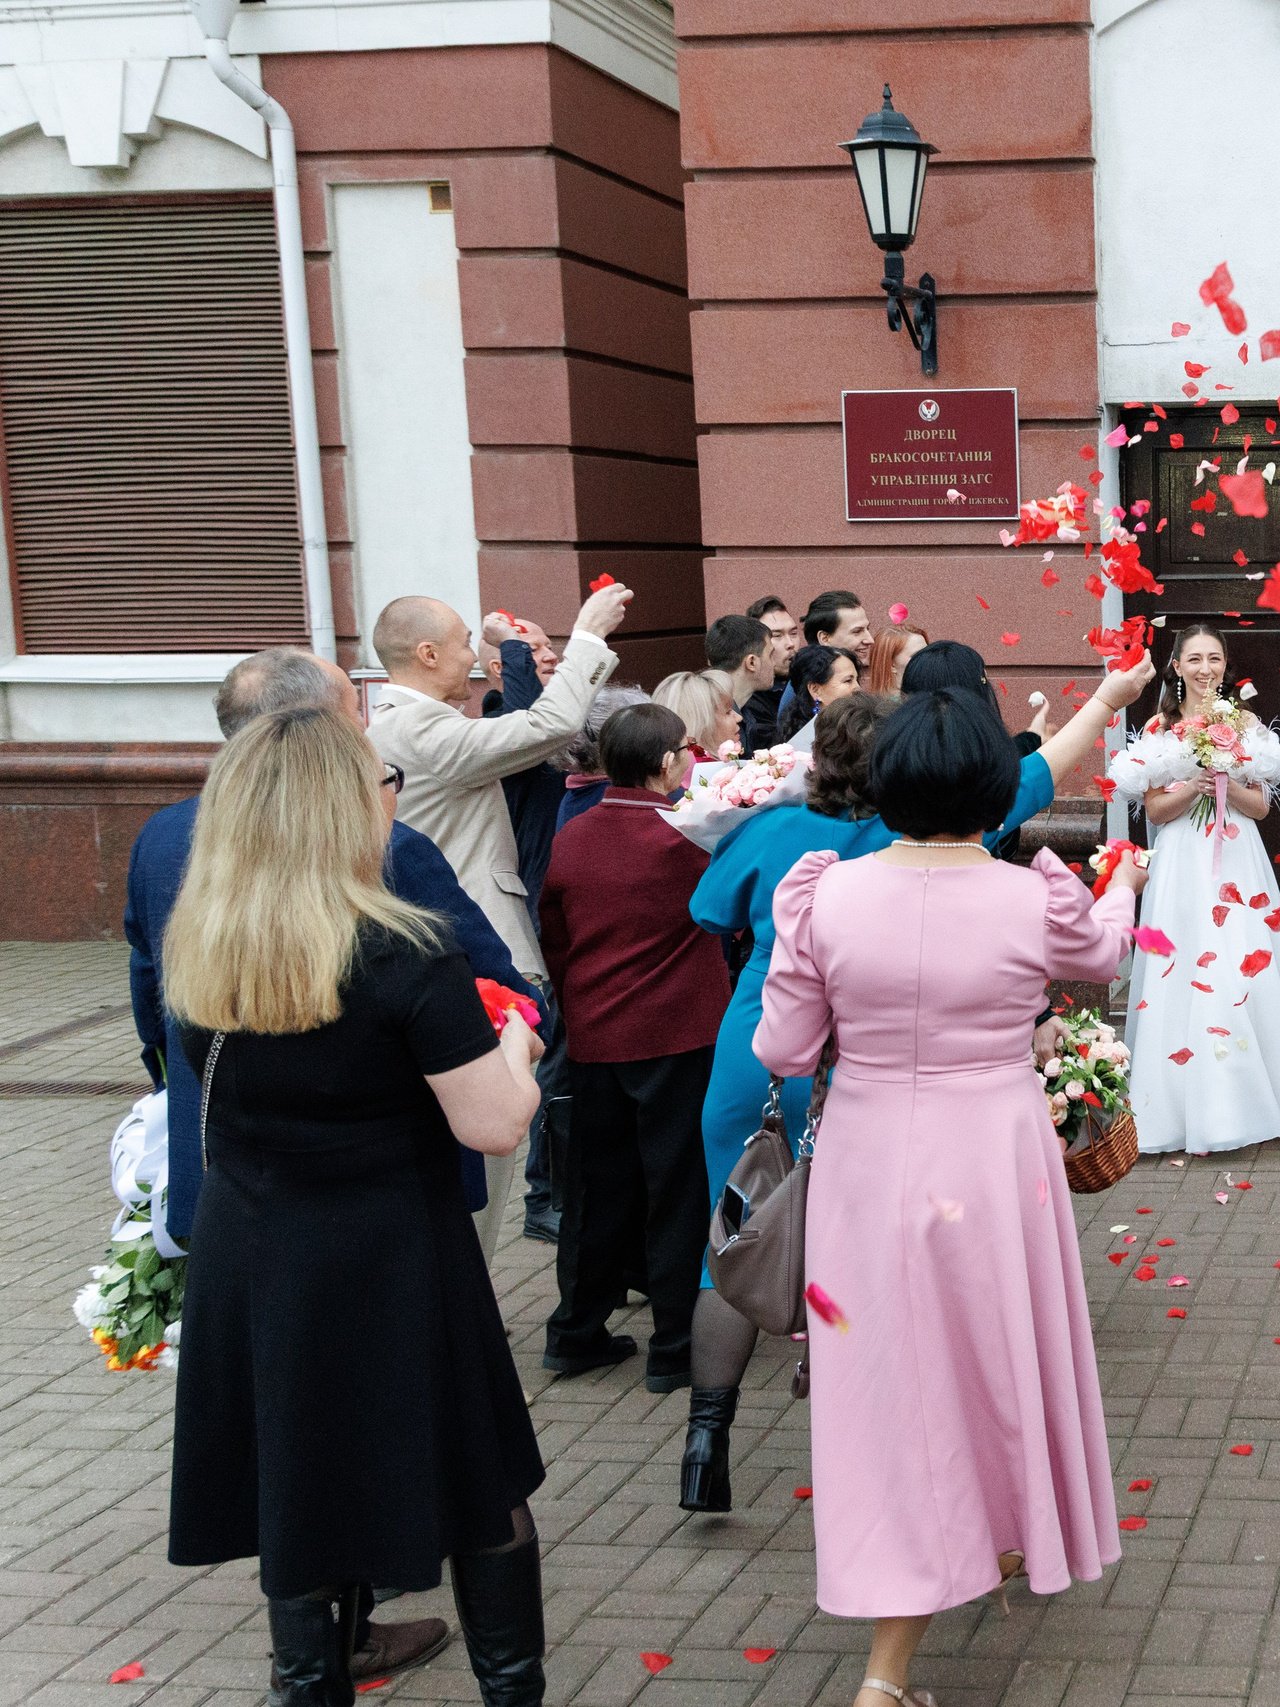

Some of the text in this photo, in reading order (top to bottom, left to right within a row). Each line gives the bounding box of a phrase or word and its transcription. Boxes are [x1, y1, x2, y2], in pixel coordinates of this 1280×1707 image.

[904, 429, 956, 441] ДВОРЕЦ
[870, 451, 992, 463] БРАКОСОЧЕТАНИЯ
[871, 473, 994, 486] УПРАВЛЕНИЯ ЗАГС
[856, 498, 930, 507] АДМИНИСТРАЦИИ
[969, 497, 1010, 505] ИЖЕВСКА
